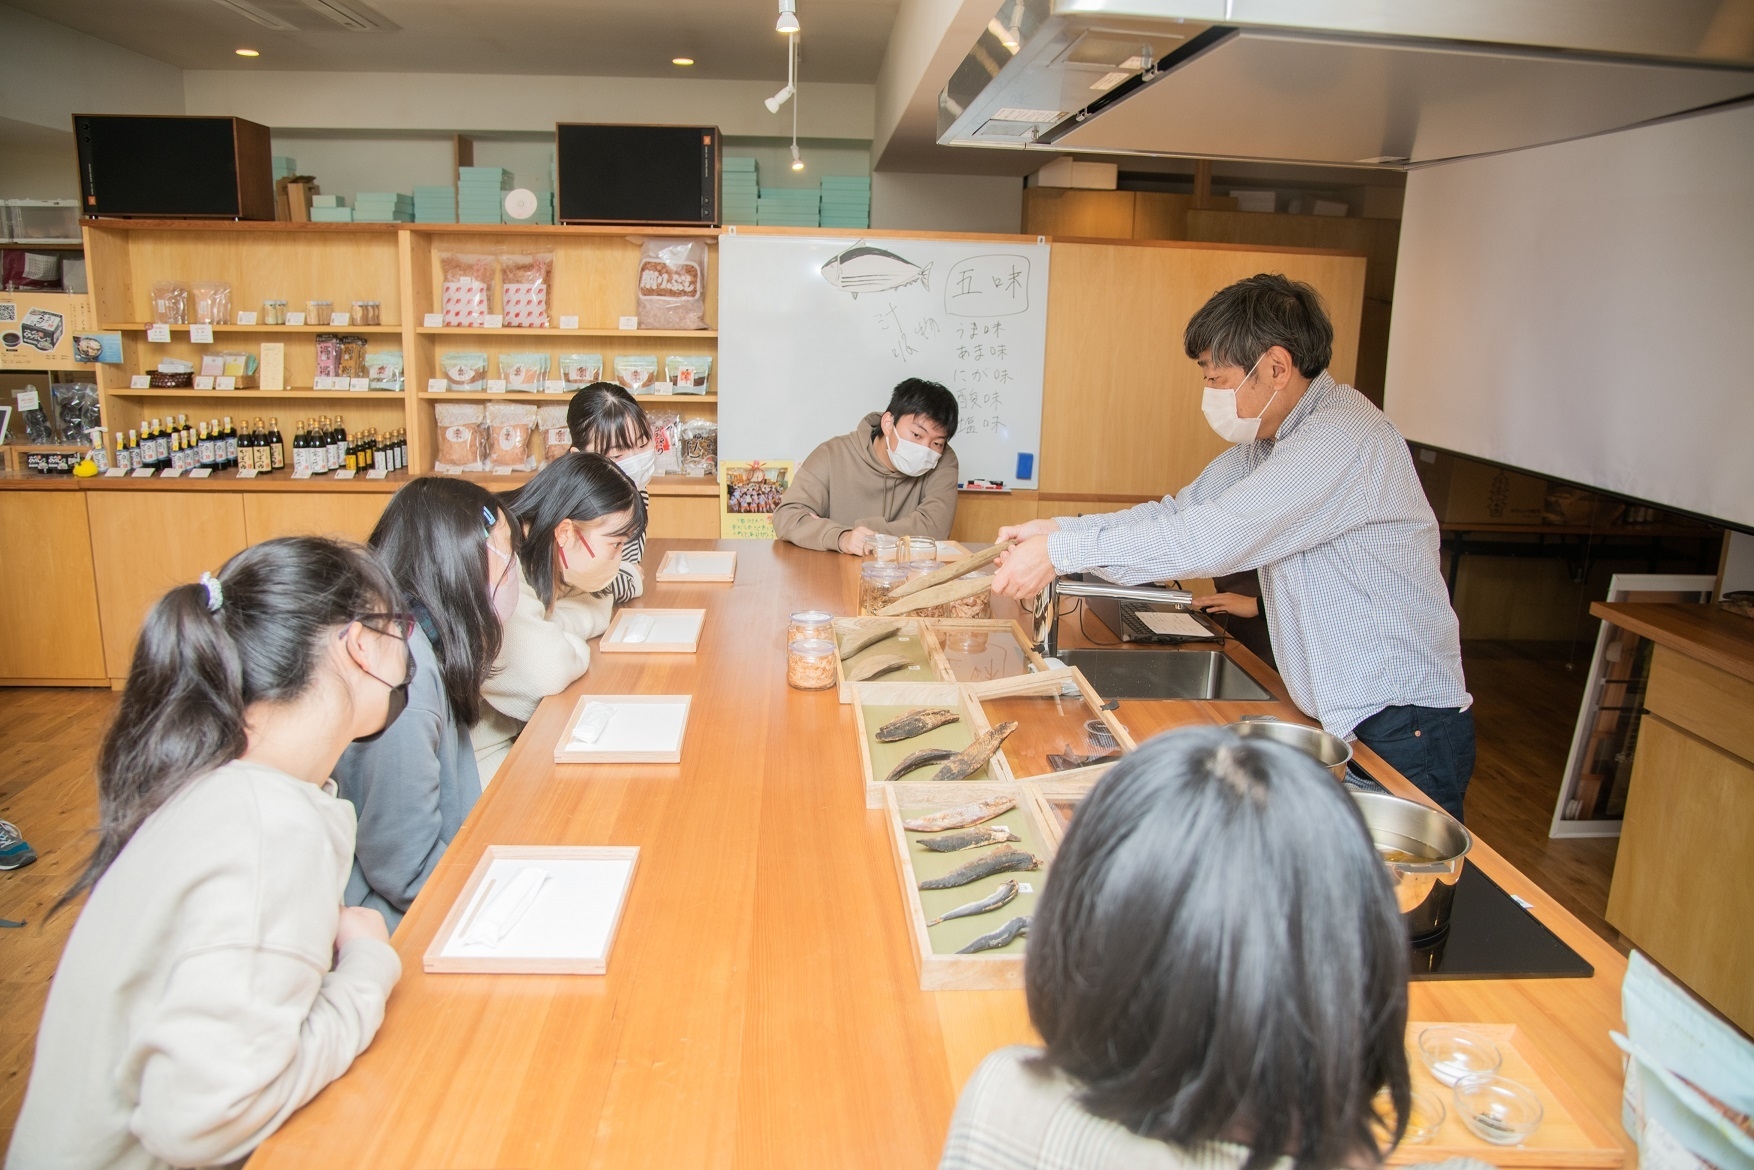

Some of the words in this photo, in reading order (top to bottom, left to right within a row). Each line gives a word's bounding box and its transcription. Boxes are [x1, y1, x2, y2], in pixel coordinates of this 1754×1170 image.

[641, 269, 694, 291] 削りぶし
[952, 264, 1022, 299] 五味
[956, 322, 1005, 340] うま味
[956, 344, 1008, 362] あま味
[953, 368, 1014, 383] にが味
[957, 388, 1004, 411] 酸味
[957, 415, 1007, 435] 塩味
